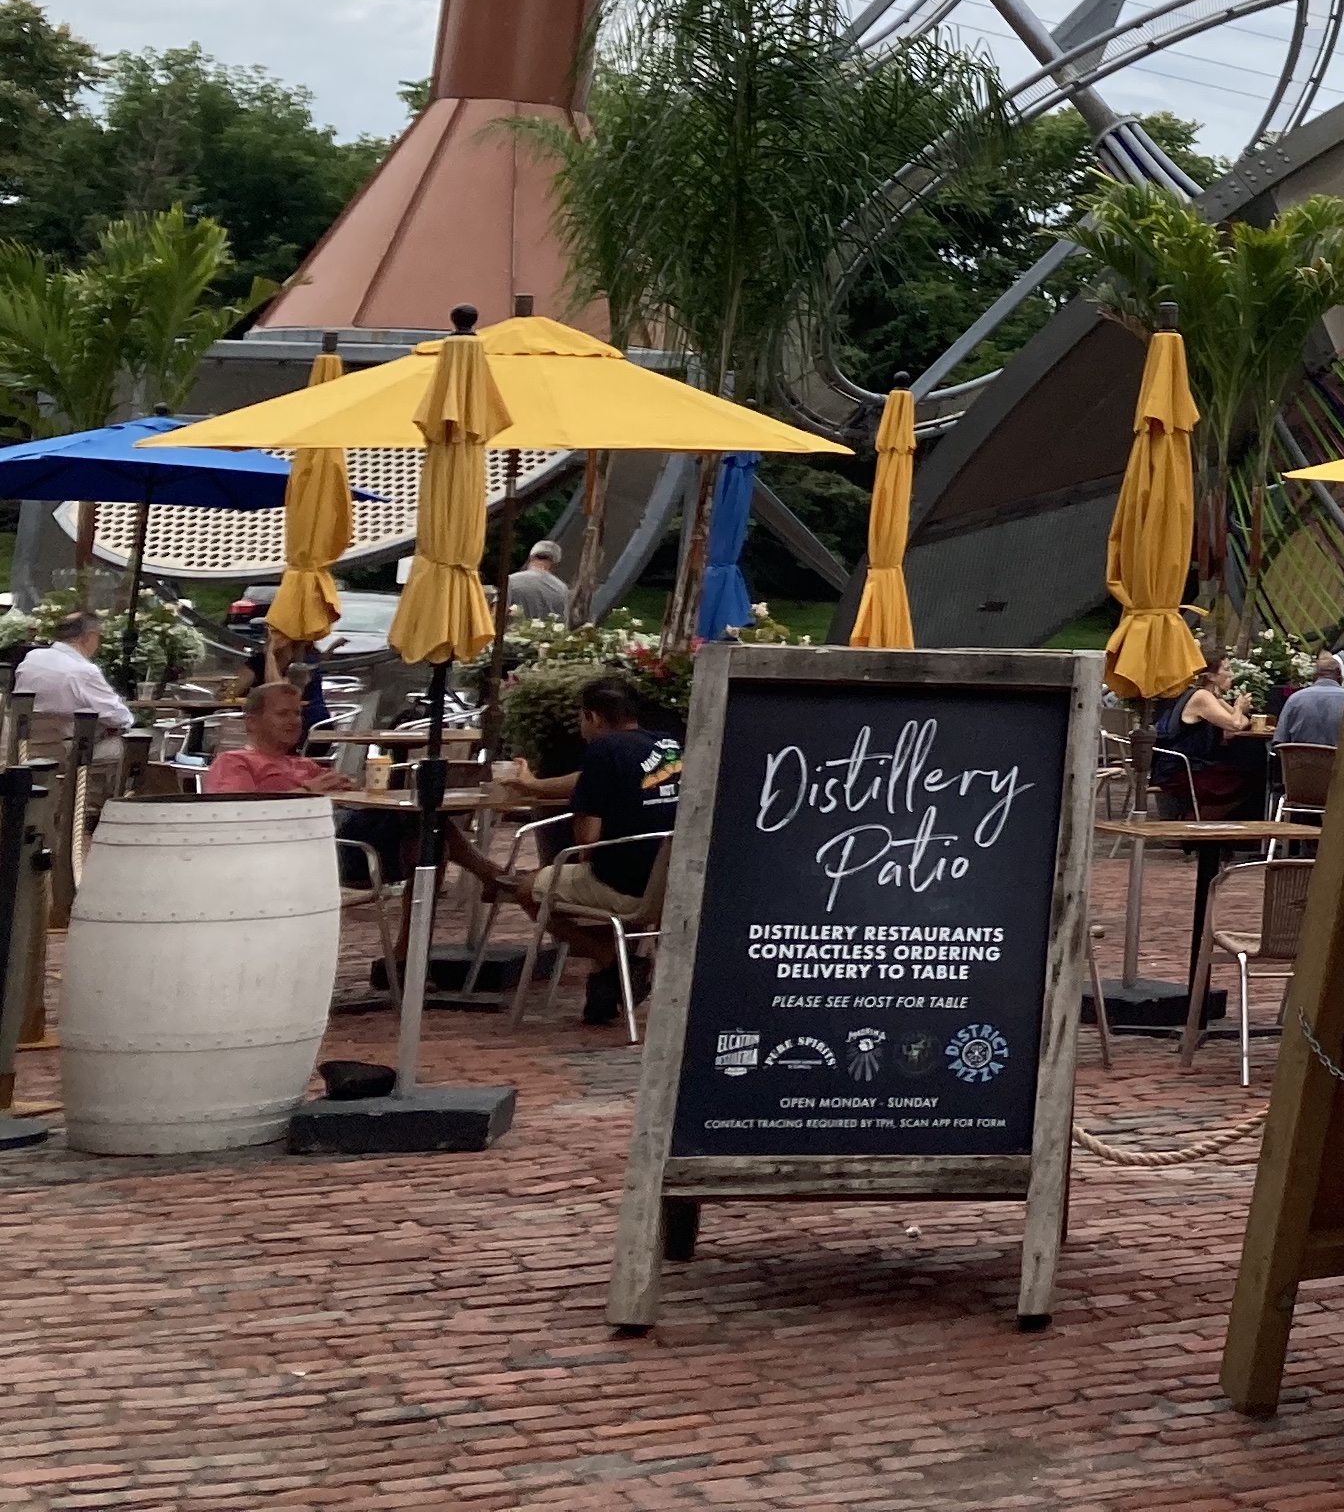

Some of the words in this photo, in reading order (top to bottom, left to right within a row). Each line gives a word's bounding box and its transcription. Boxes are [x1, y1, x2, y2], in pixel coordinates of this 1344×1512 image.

[756, 718, 1036, 847] Distillery
[816, 805, 969, 912] Patio
[749, 925, 857, 941] DISTILLERY
[864, 927, 1004, 942] RESTAURANTS
[748, 944, 887, 960] CONTACTLESS
[893, 946, 1001, 961] ORDERING
[777, 963, 871, 979] DELIVERY
[878, 964, 904, 979] TO
[911, 965, 970, 980] TABLE
[771, 996, 822, 1008] PLEASE
[825, 996, 850, 1008] SEE
[853, 996, 894, 1009] HOST
[896, 996, 925, 1009] FOR
[929, 996, 969, 1009] TABLE
[945, 1024, 1009, 1058] DISTRICT
[798, 1037, 836, 1065] SPIRITS
[948, 1059, 1004, 1083] PIZZA
[780, 1098, 816, 1108] OPEN
[819, 1098, 877, 1108] MONDAY
[887, 1097, 939, 1108] SUNDAY
[704, 1119, 754, 1129] CONTACT
[757, 1119, 803, 1128] TRACING
[806, 1119, 857, 1128] REQUIRED
[899, 1118, 929, 1128] SCAN
[931, 1119, 951, 1128] APP
[953, 1119, 974, 1128] FOR
[976, 1119, 1006, 1128] FORM
